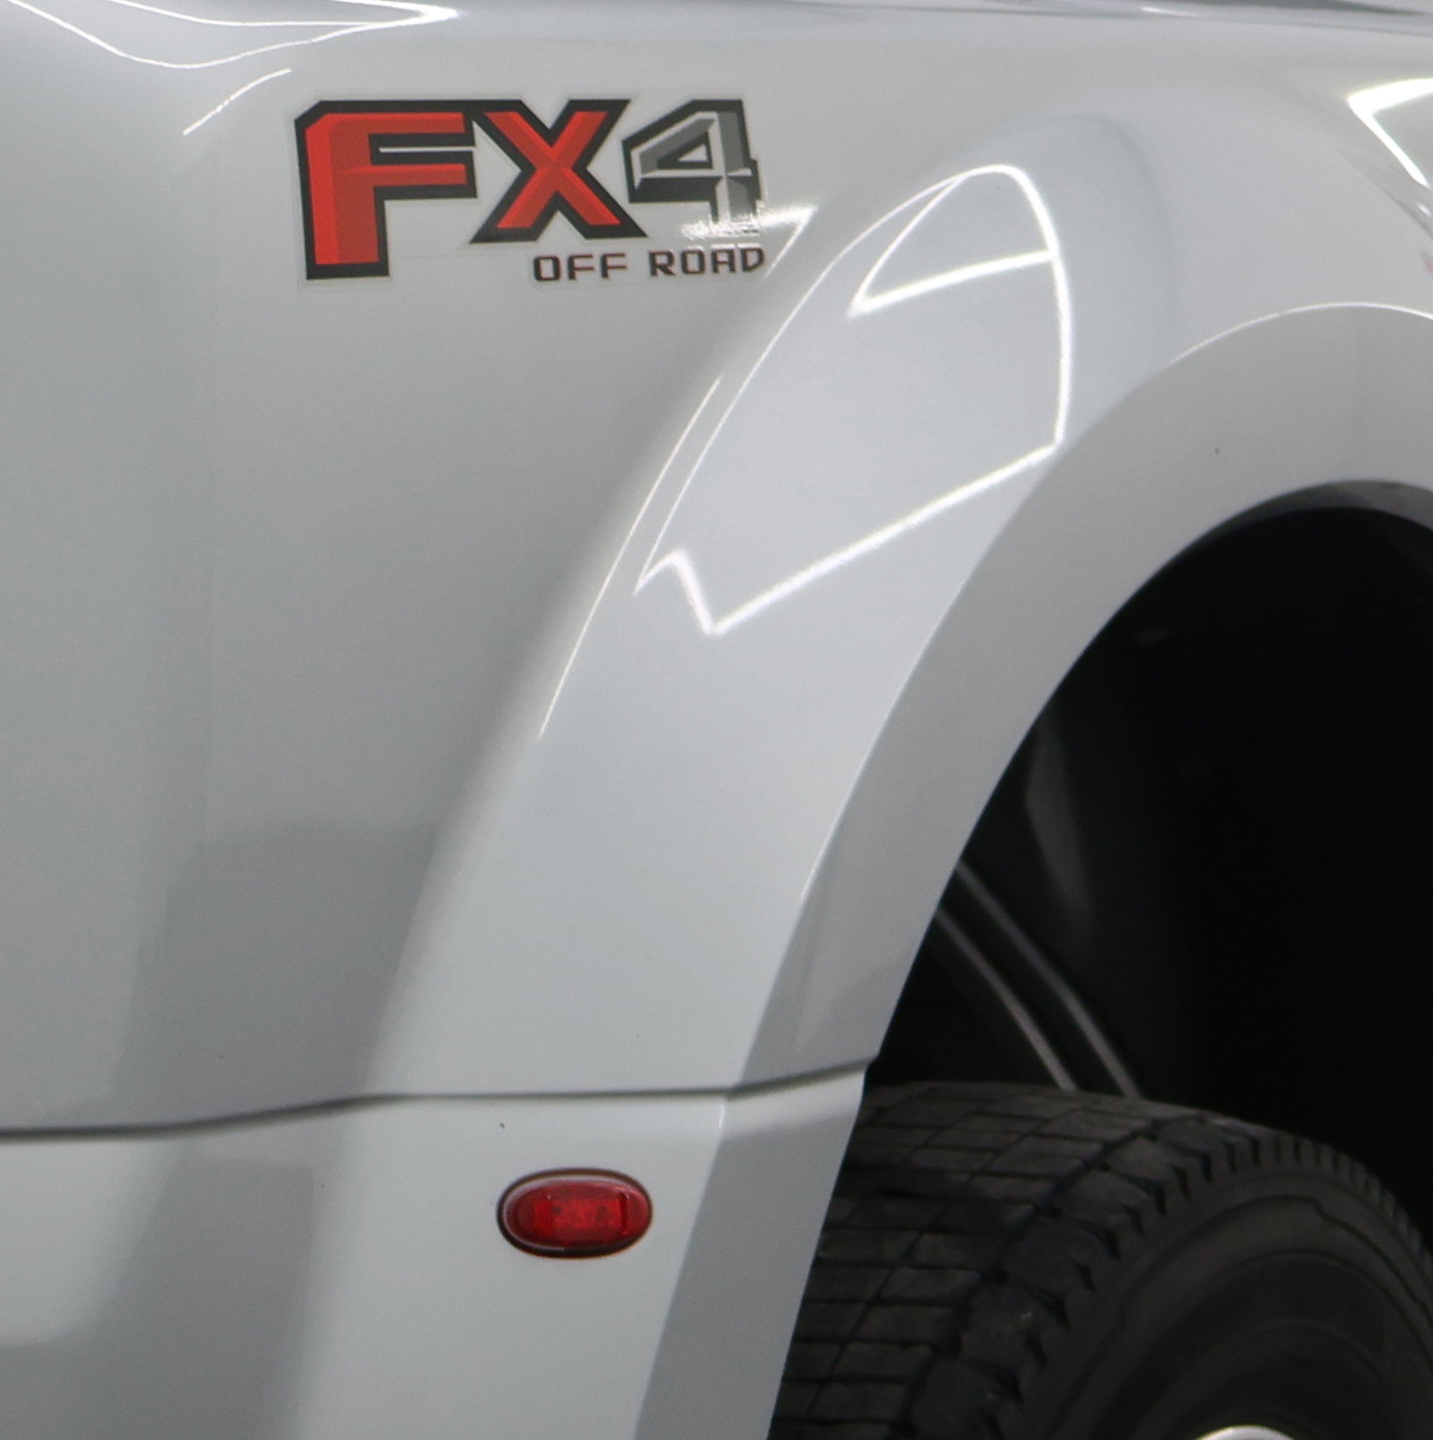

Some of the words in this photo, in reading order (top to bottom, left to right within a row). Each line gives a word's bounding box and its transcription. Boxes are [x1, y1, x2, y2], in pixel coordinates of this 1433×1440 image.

[294, 99, 764, 280] FX4
[533, 252, 627, 282] OFF
[647, 246, 766, 279] ROAD
